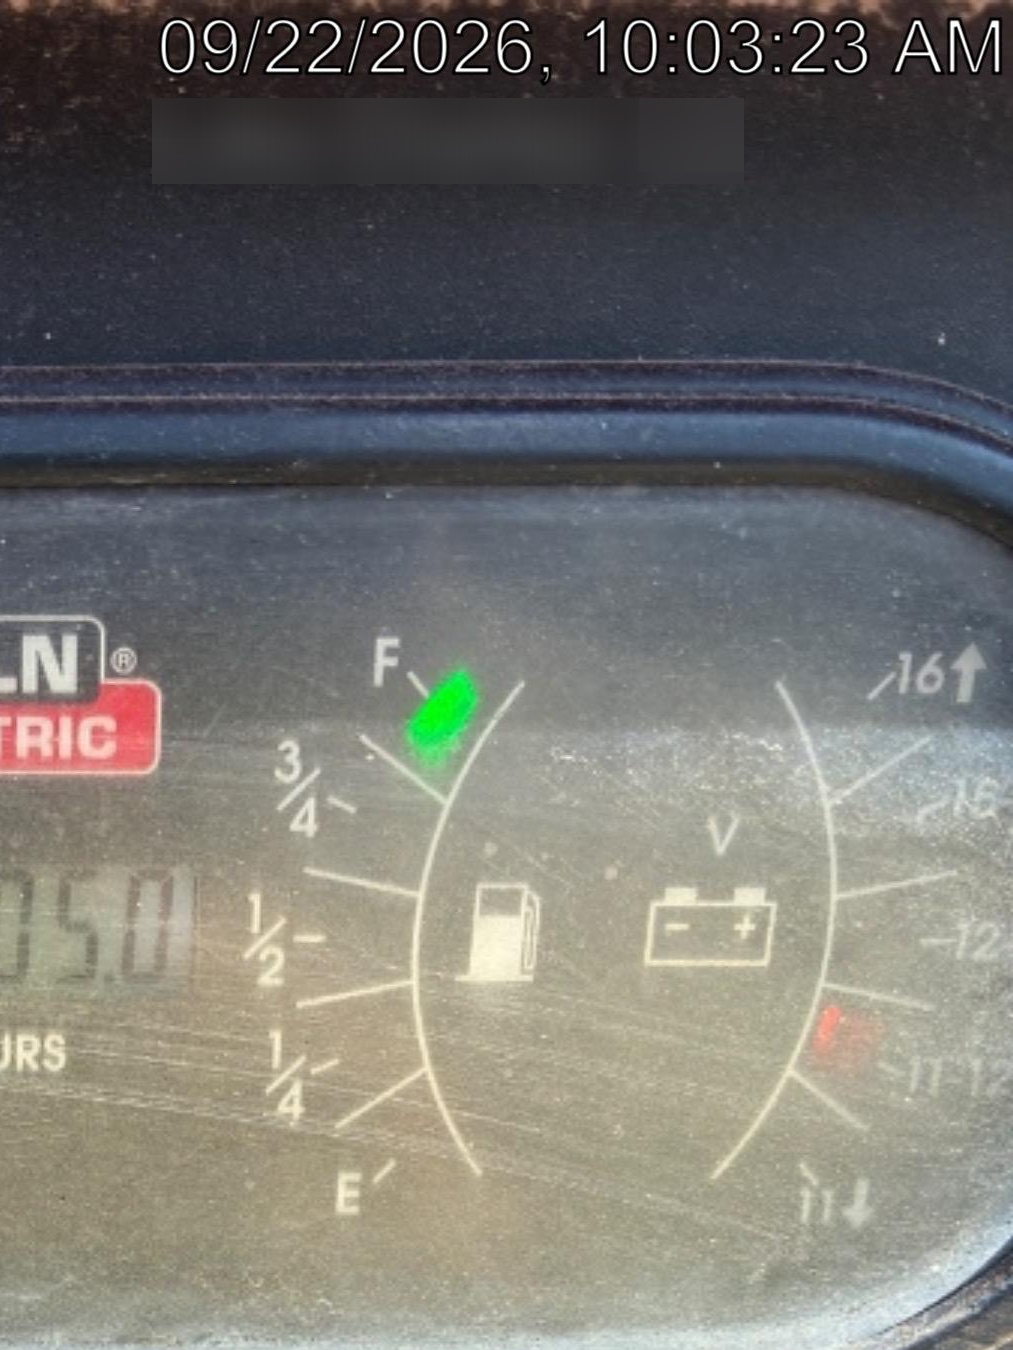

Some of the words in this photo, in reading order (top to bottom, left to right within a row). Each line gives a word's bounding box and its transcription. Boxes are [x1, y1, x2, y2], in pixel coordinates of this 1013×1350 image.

[373, 637, 401, 687] F
[898, 650, 946, 694] 16
[707, 814, 740, 857] V
[955, 920, 1001, 962] 12
[336, 1172, 362, 1217] E
